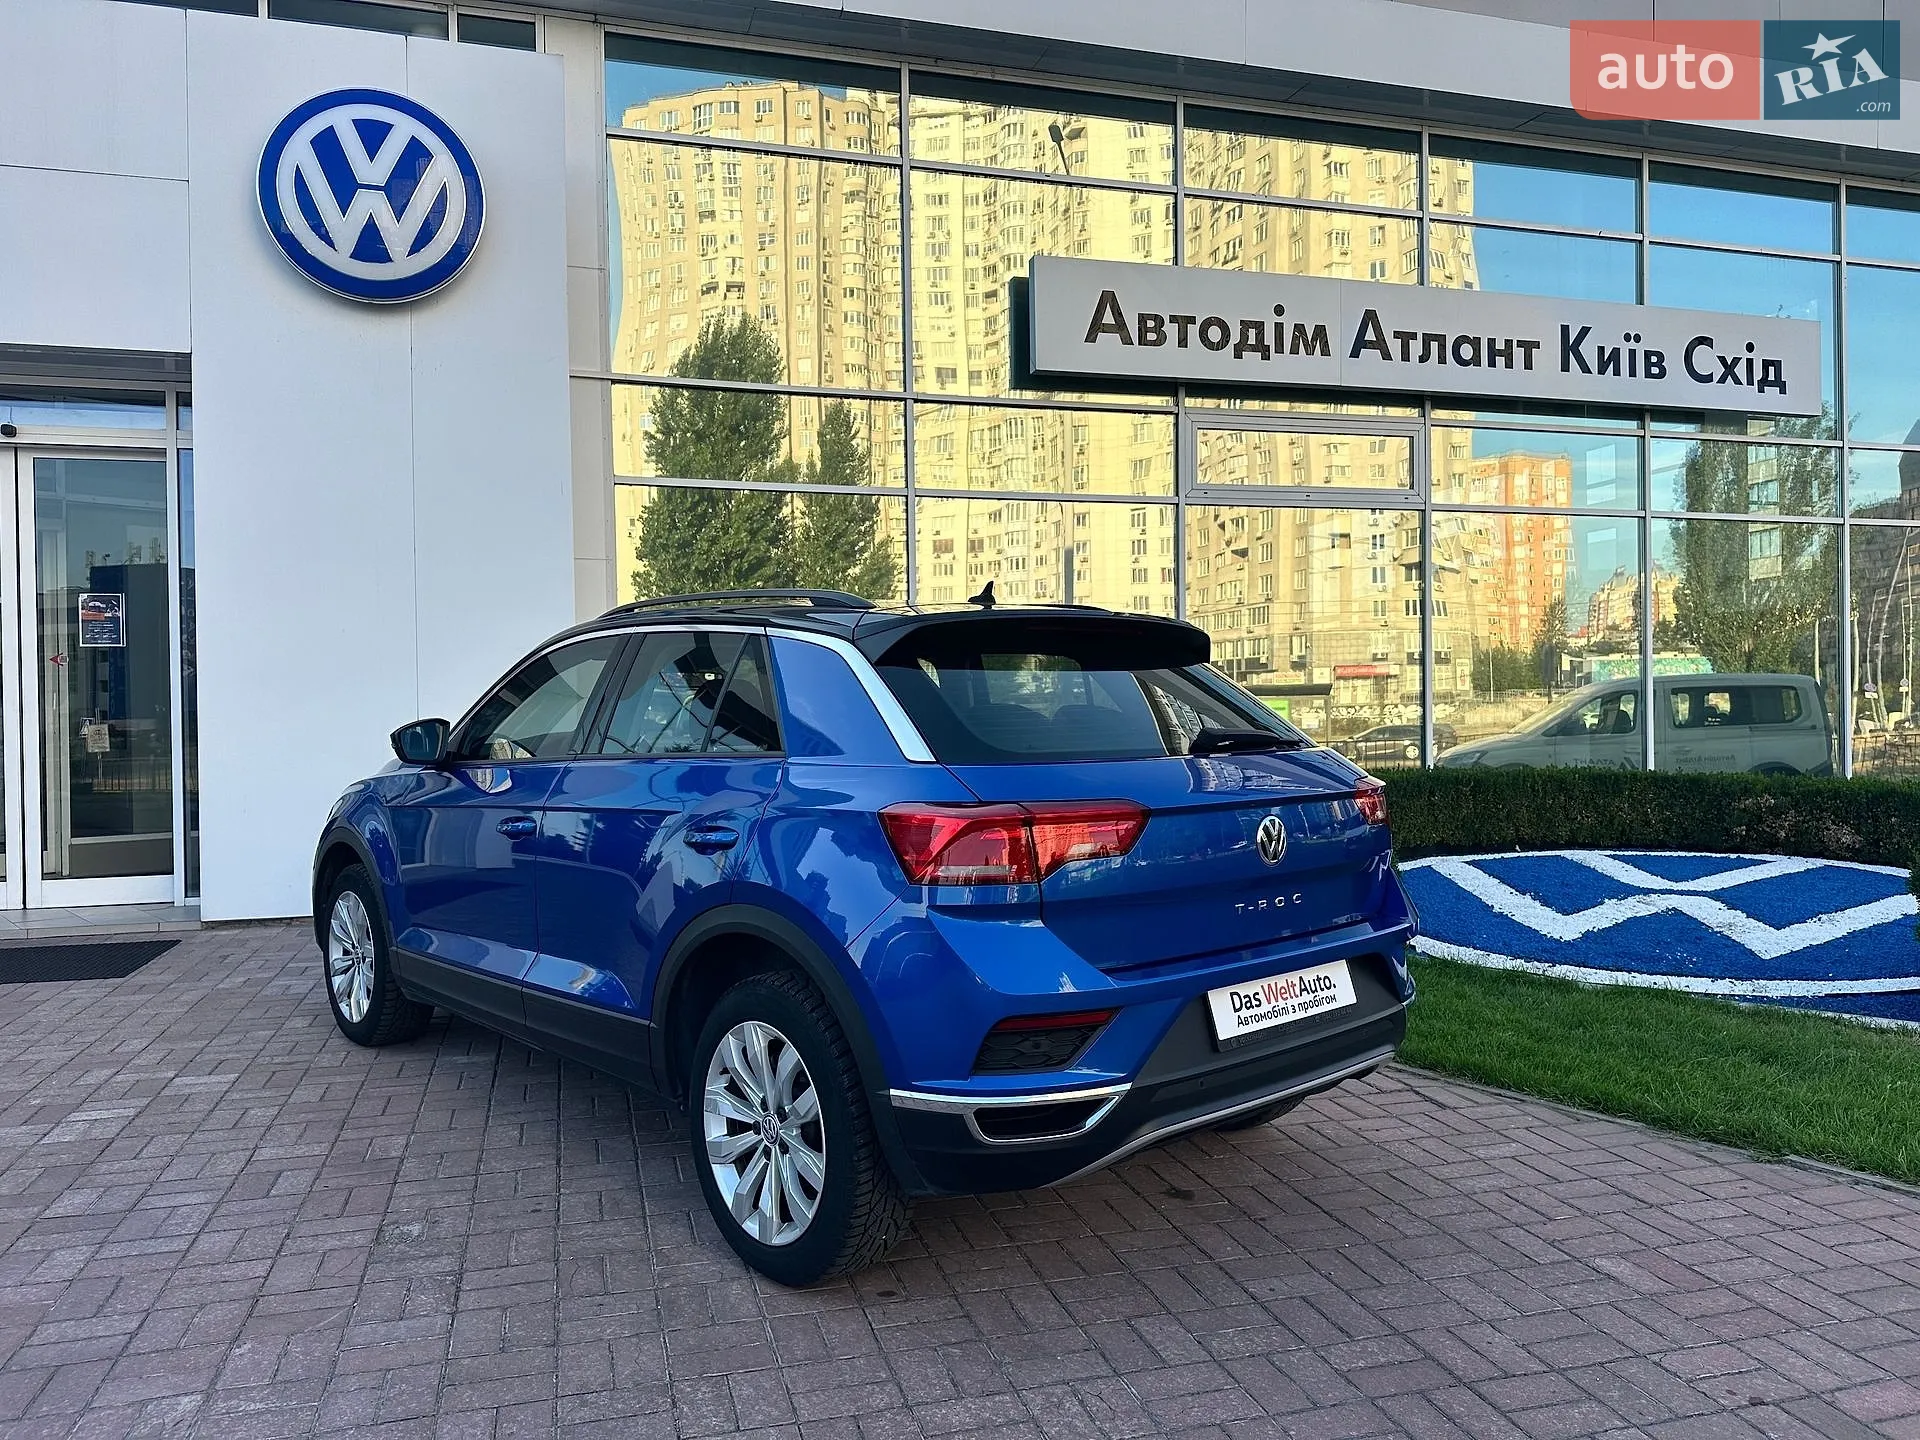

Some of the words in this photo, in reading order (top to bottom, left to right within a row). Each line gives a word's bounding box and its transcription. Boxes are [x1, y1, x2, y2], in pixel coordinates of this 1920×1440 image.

[1083, 289, 1332, 361] Автодім
[1348, 308, 1541, 371] Атлант
[1559, 323, 1668, 380] Київ
[1683, 335, 1788, 396] Схід
[1234, 893, 1303, 915] T-ROC
[1229, 991, 1262, 1013] Das
[1237, 1003, 1290, 1028] Автомобілі
[1291, 1004, 1297, 1014] з
[1298, 993, 1338, 1014] пробігом
